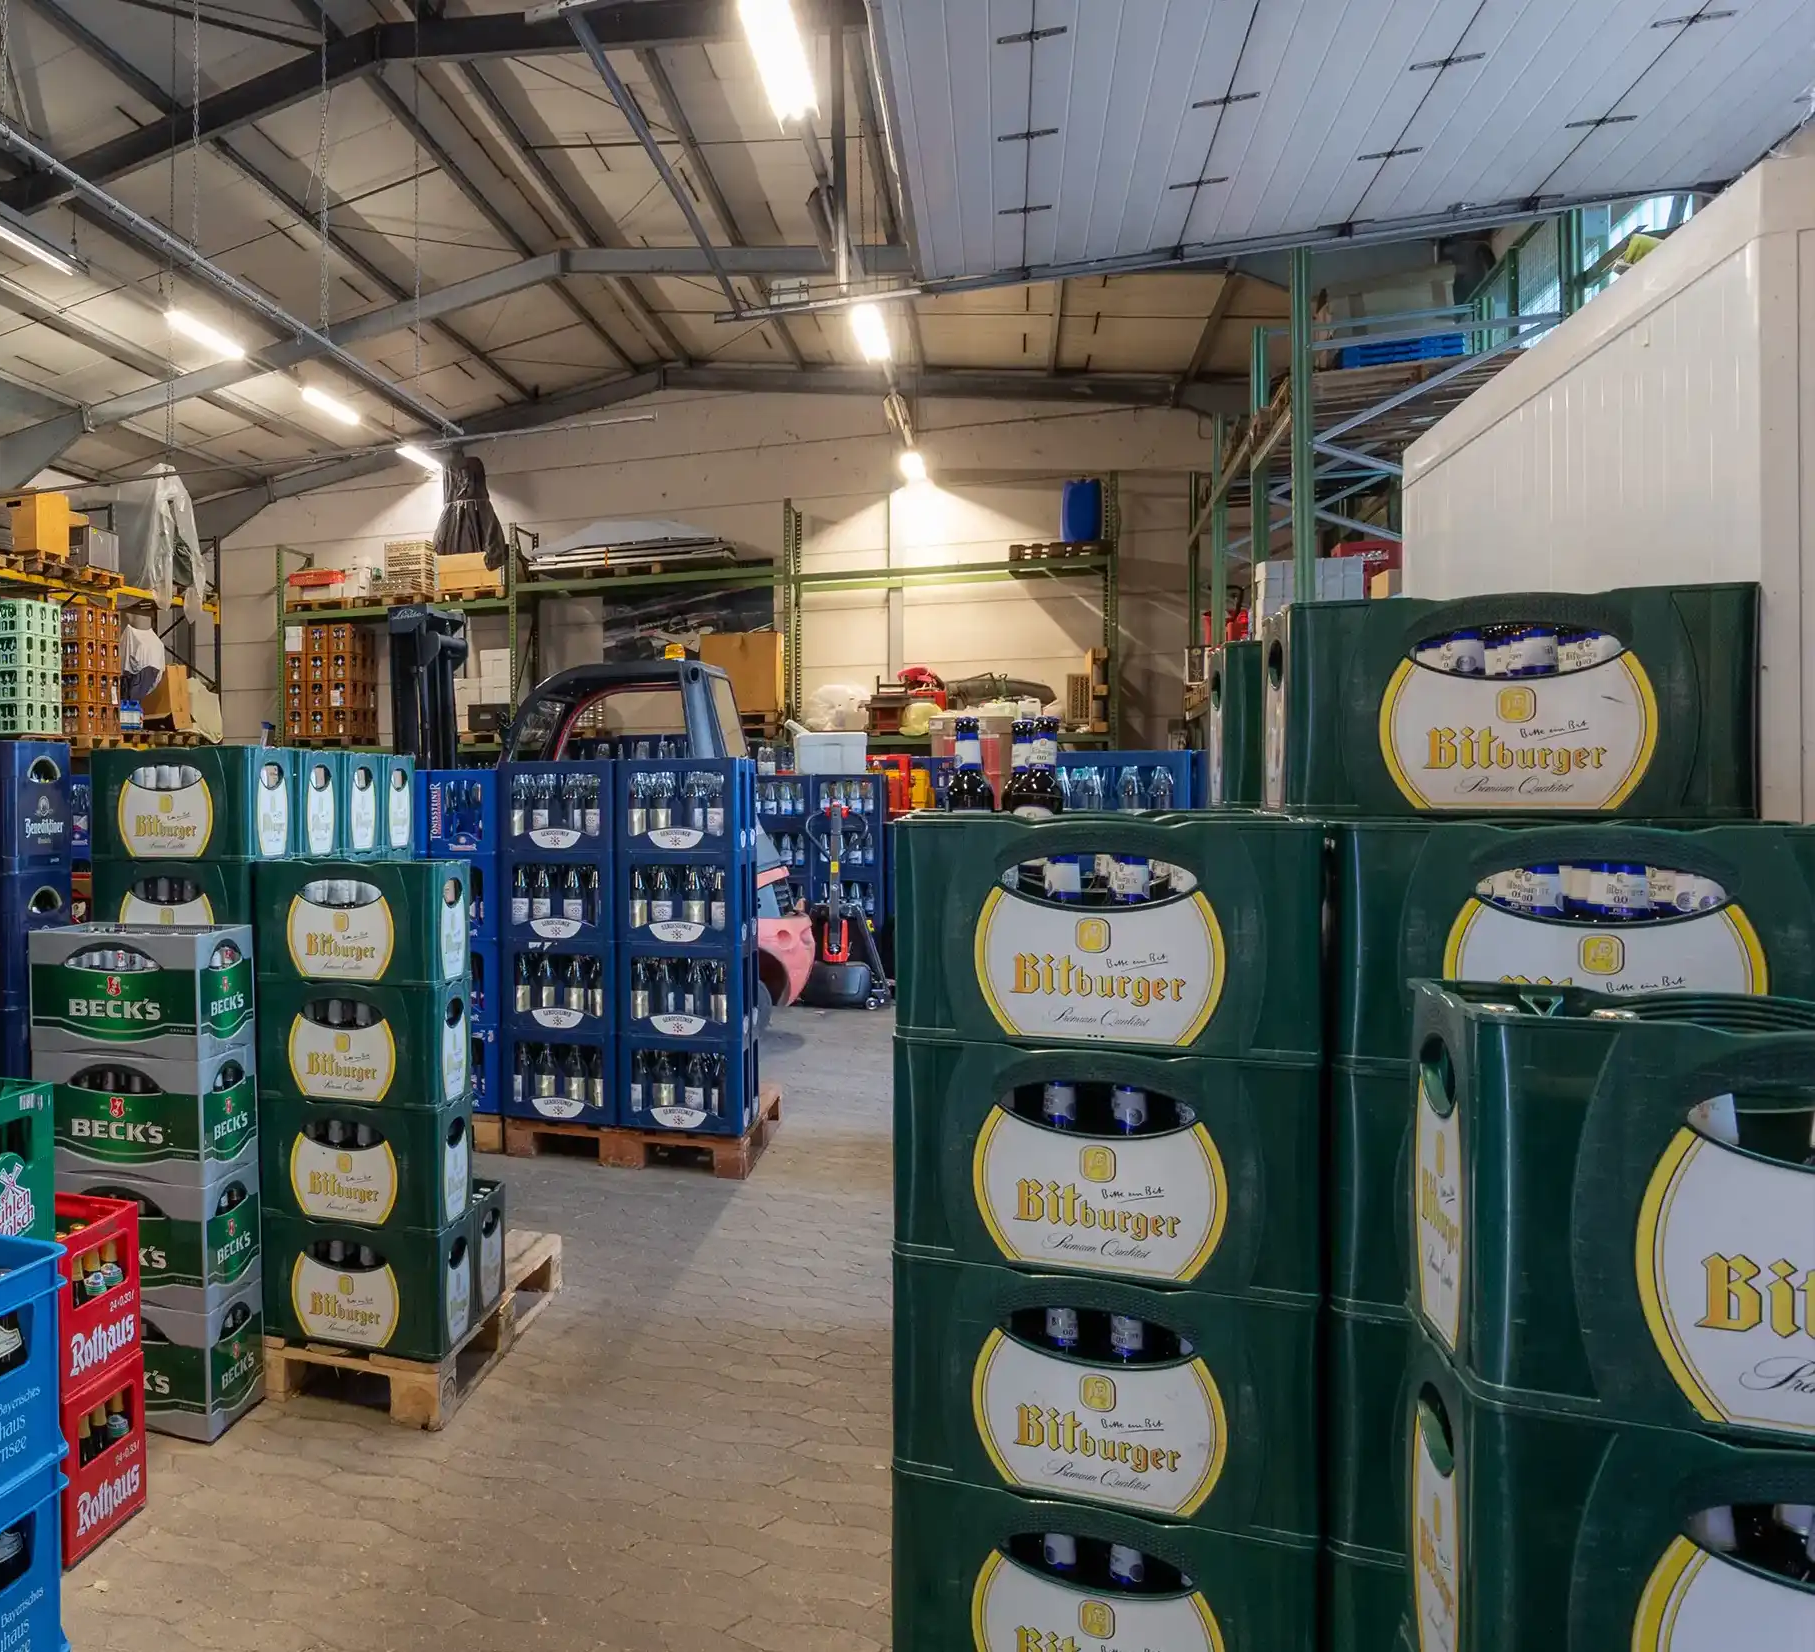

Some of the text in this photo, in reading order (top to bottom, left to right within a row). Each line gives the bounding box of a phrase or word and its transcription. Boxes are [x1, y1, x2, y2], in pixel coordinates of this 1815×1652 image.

[391, 608, 425, 620] Linde
[1423, 726, 1607, 776] Bitburger
[1454, 776, 1575, 795] Premium Qualität
[24, 817, 64, 838] Benediktiner
[134, 815, 197, 840] Bitburger
[305, 932, 376, 961] Bitburger
[1009, 952, 1186, 1007] Bitburger
[1605, 982, 1634, 994] Bitte
[1662, 976, 1686, 986] Bit
[68, 998, 162, 1021] BECK'S
[210, 992, 244, 1017] BECK'S
[1048, 1007, 1097, 1024] Premium
[305, 1051, 377, 1082] Bitburger
[71, 1118, 164, 1145] BECK'S
[213, 1111, 248, 1142] BECK'S
[307, 1170, 380, 1204] Bitburger
[1101, 1189, 1124, 1199] Bitte
[1145, 1186, 1165, 1195] Bit
[1013, 1178, 1182, 1242] Bitburger
[216, 1230, 251, 1265] BECK'S
[1042, 1232, 1151, 1259] Premium Qualität
[309, 1291, 381, 1326] Bitburger
[70, 1314, 135, 1377] Rothaus
[221, 1351, 256, 1390] BECK'S
[1013, 1402, 1182, 1473] Bitburger
[1100, 1418, 1124, 1429] Bitte
[1145, 1418, 1164, 1428] Bit
[1040, 1459, 1153, 1492] Premium Qualität
[76, 1463, 141, 1537] Rothaus
[0, 1586, 44, 1628] Bayerisches
